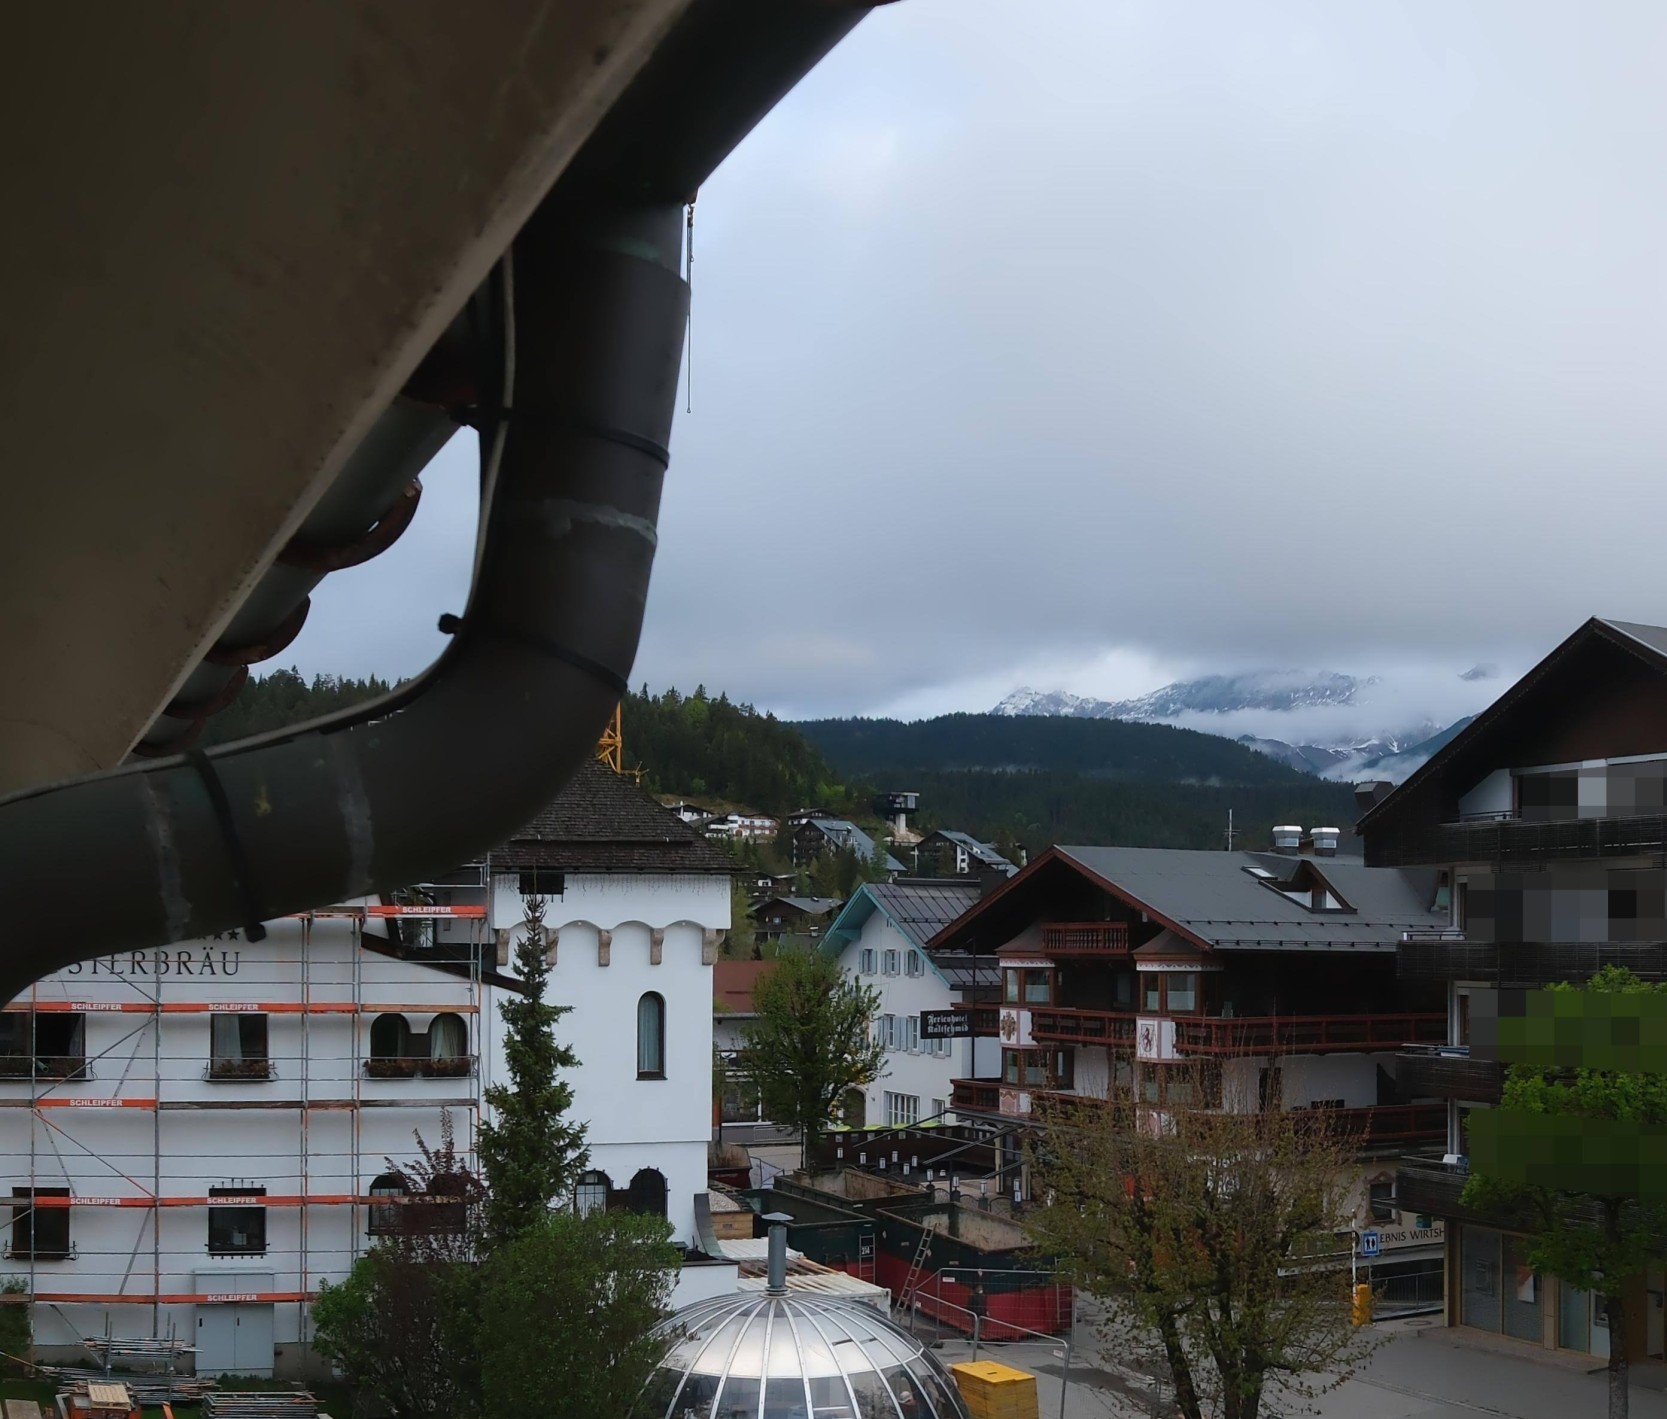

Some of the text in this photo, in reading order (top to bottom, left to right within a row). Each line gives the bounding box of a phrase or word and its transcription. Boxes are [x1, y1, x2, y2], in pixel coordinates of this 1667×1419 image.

[402, 906, 452, 914] SCHLEIPFER
[71, 1003, 122, 1011] SCHLEIPFER
[208, 1003, 259, 1011] SCHLEIPFER
[70, 1099, 123, 1107] SCHLEIPFER
[70, 1197, 121, 1205] SCHLEIPFER
[207, 1294, 257, 1302] SCHLEIPFER
